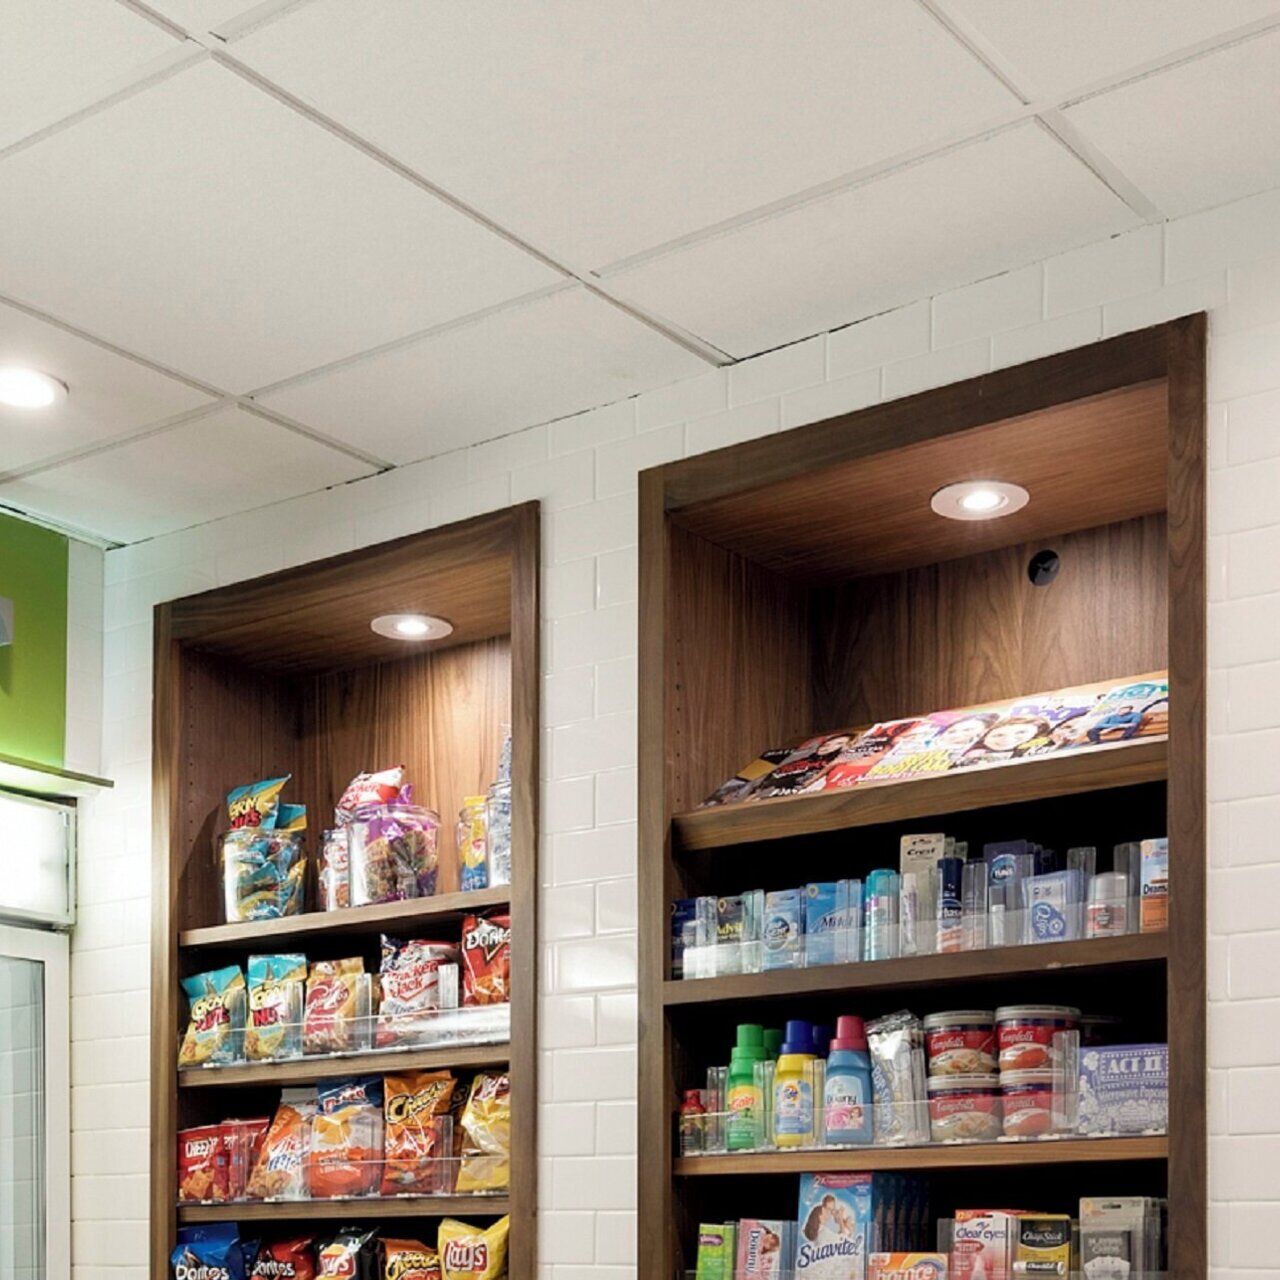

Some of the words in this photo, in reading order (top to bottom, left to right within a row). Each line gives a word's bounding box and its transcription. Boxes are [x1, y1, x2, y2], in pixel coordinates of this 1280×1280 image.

[1107, 1057, 1141, 1074] ACT
[1144, 1055, 1162, 1072] II
[956, 1227, 982, 1239] Clear
[983, 1229, 1006, 1240] eyes
[445, 1241, 487, 1272] Lay's
[797, 1235, 865, 1269] Suavitel
